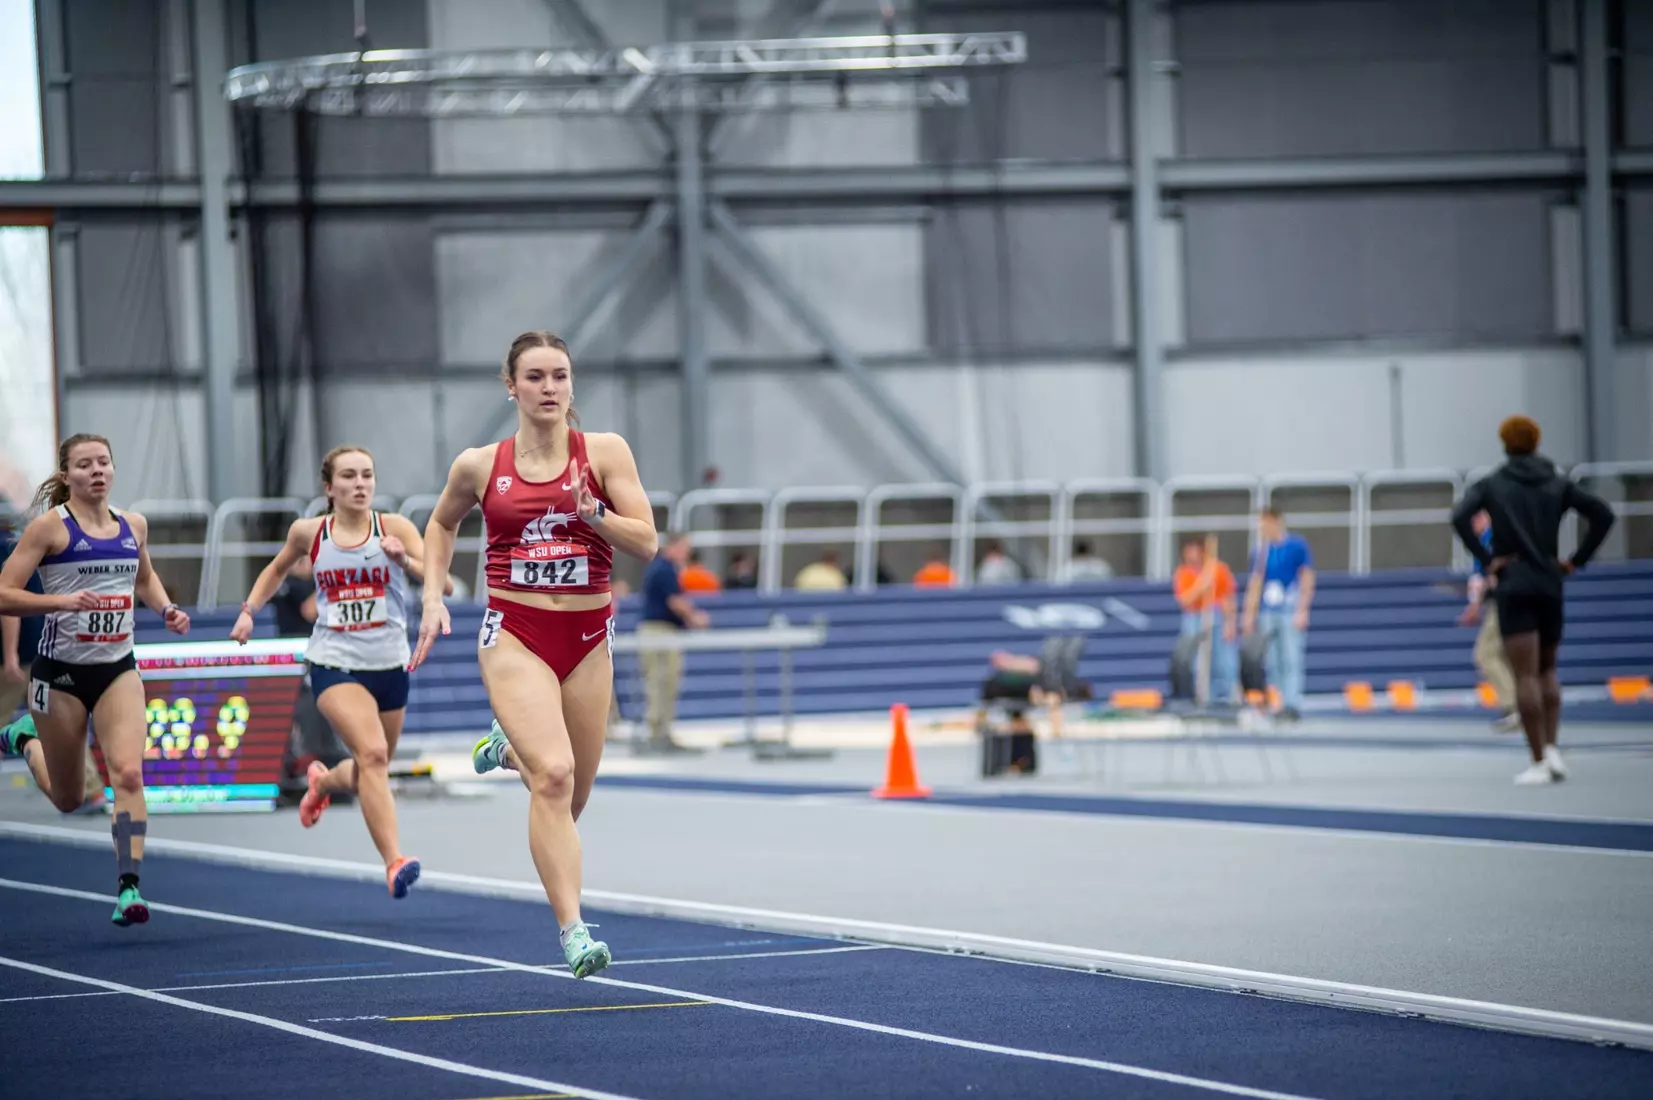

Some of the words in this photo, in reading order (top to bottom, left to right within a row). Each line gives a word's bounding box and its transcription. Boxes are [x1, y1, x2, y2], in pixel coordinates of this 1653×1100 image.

[528, 546, 548, 558] WSU
[550, 545, 572, 556] OPEN
[77, 565, 110, 575] WEBER
[523, 559, 577, 584] 842
[110, 598, 125, 608] OPEN
[355, 586, 373, 597] OPEN
[88, 611, 126, 634] 887
[337, 600, 376, 624] 307
[483, 610, 498, 646] 5
[35, 683, 46, 711] 4
